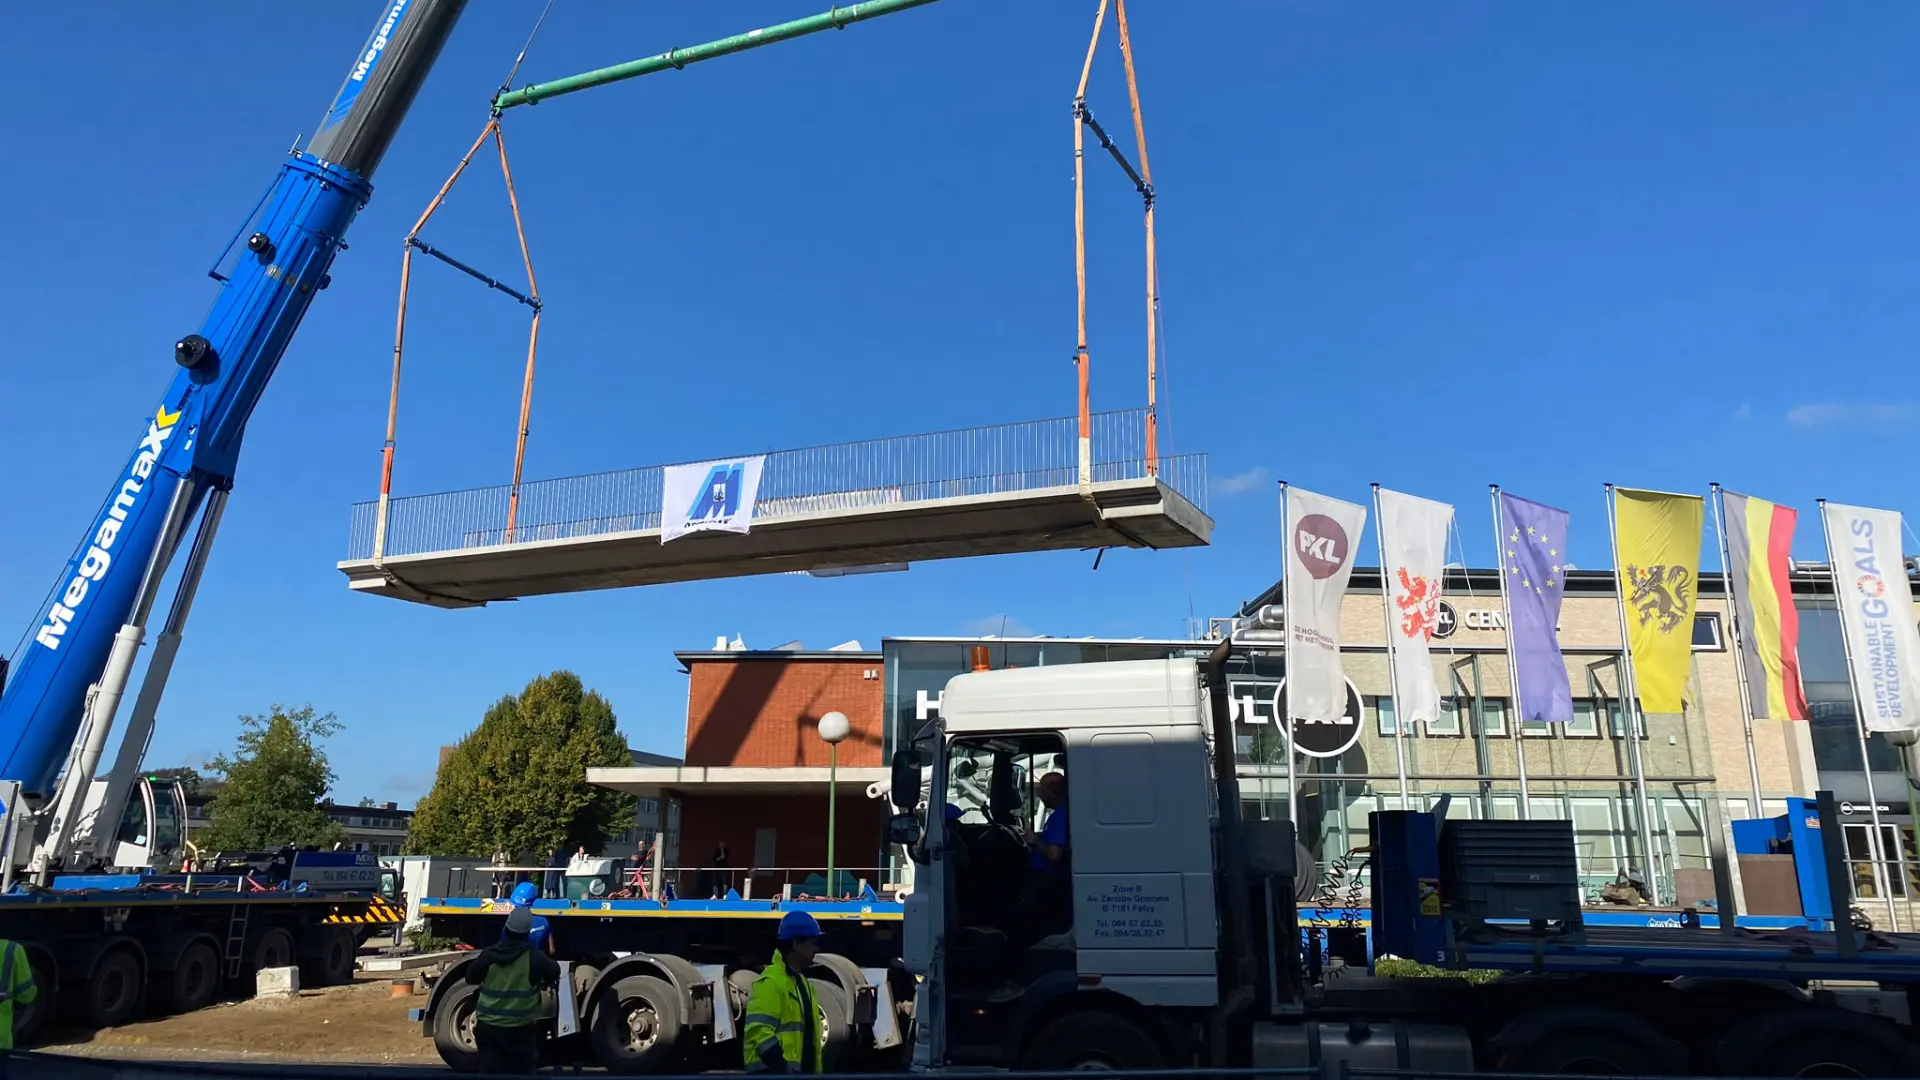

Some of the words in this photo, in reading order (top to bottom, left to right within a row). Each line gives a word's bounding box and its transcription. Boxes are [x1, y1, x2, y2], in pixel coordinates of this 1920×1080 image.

[1300, 530, 1340, 564] PXL
[1865, 621, 1889, 718] SUSTAINABLE
[1880, 622, 1902, 718] DEVELOPMENT
[1113, 885, 1133, 893] Zone
